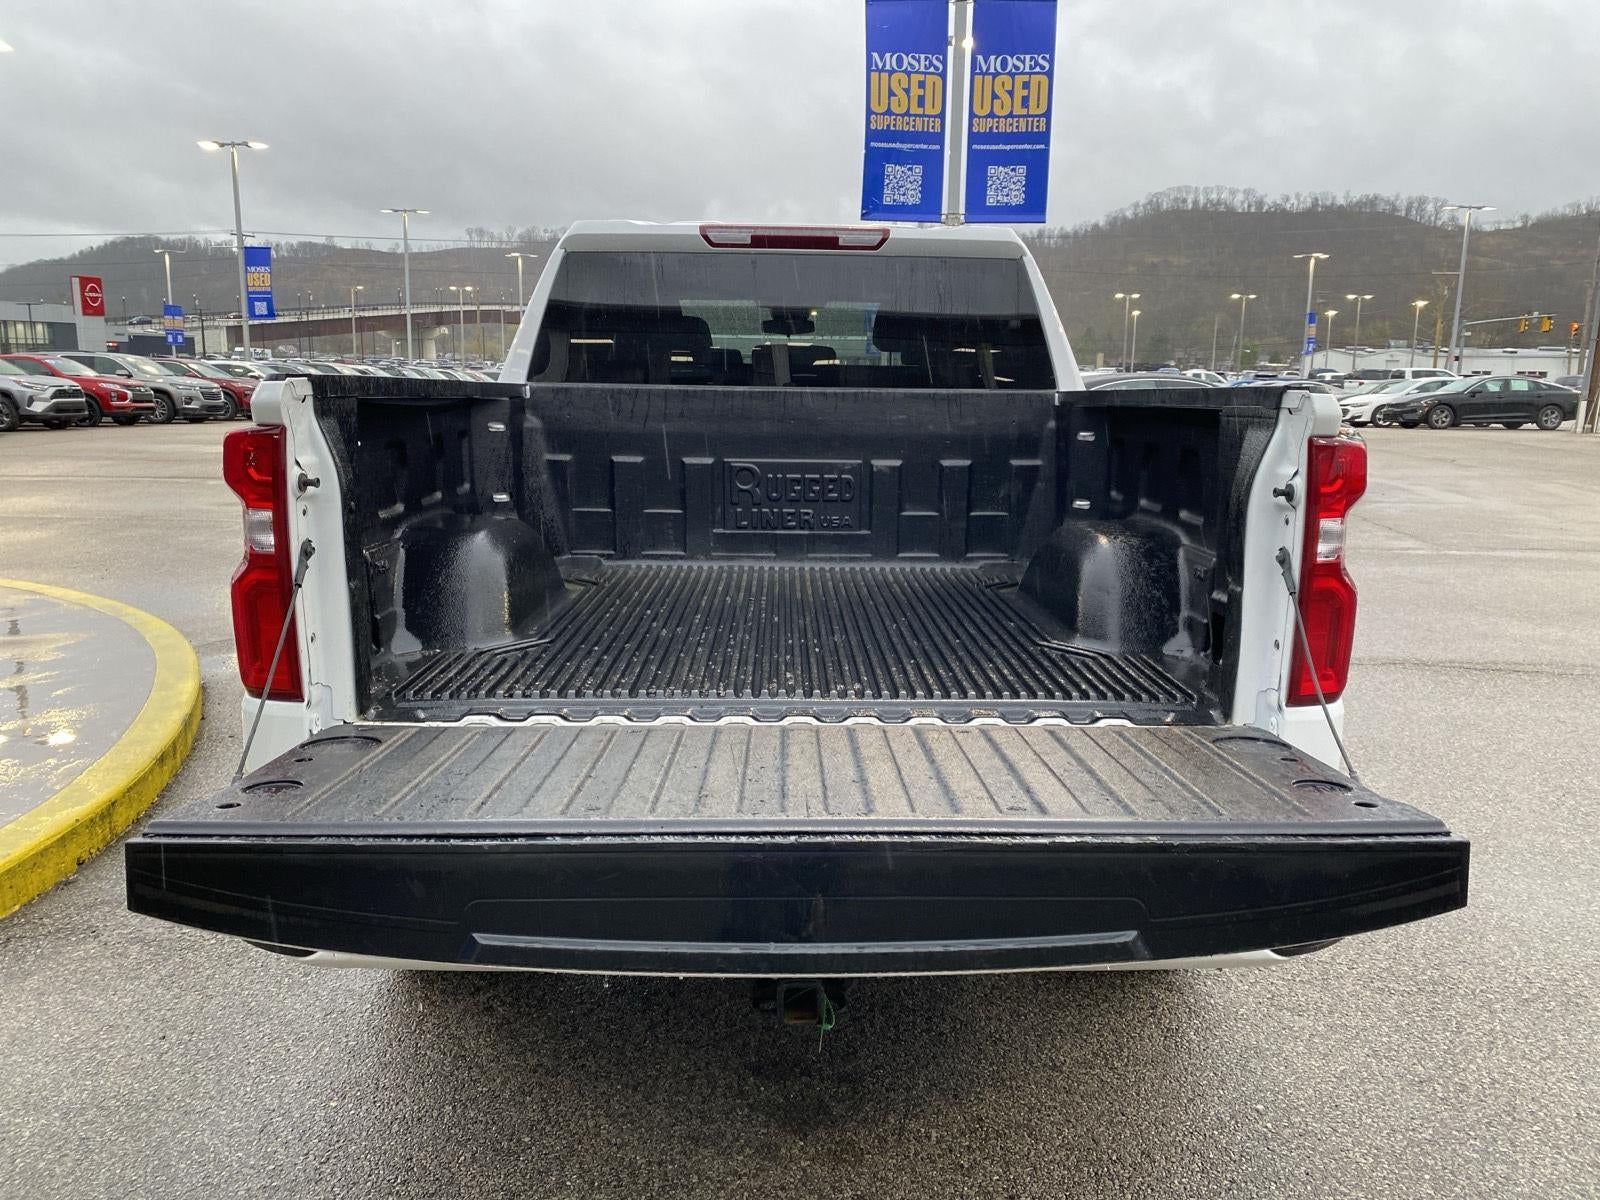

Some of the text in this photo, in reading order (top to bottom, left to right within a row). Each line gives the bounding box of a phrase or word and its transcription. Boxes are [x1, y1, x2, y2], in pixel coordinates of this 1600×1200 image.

[871, 52, 943, 73] MOSES
[975, 54, 1050, 73] MOSES
[870, 72, 943, 115] USED
[972, 74, 1049, 116] USED
[870, 115, 941, 132] SUPERCENTER
[972, 117, 1046, 133] SUPERCENTER
[247, 272, 271, 287] USED
[730, 463, 855, 505] RUGGED
[736, 508, 853, 530] LINER USA
